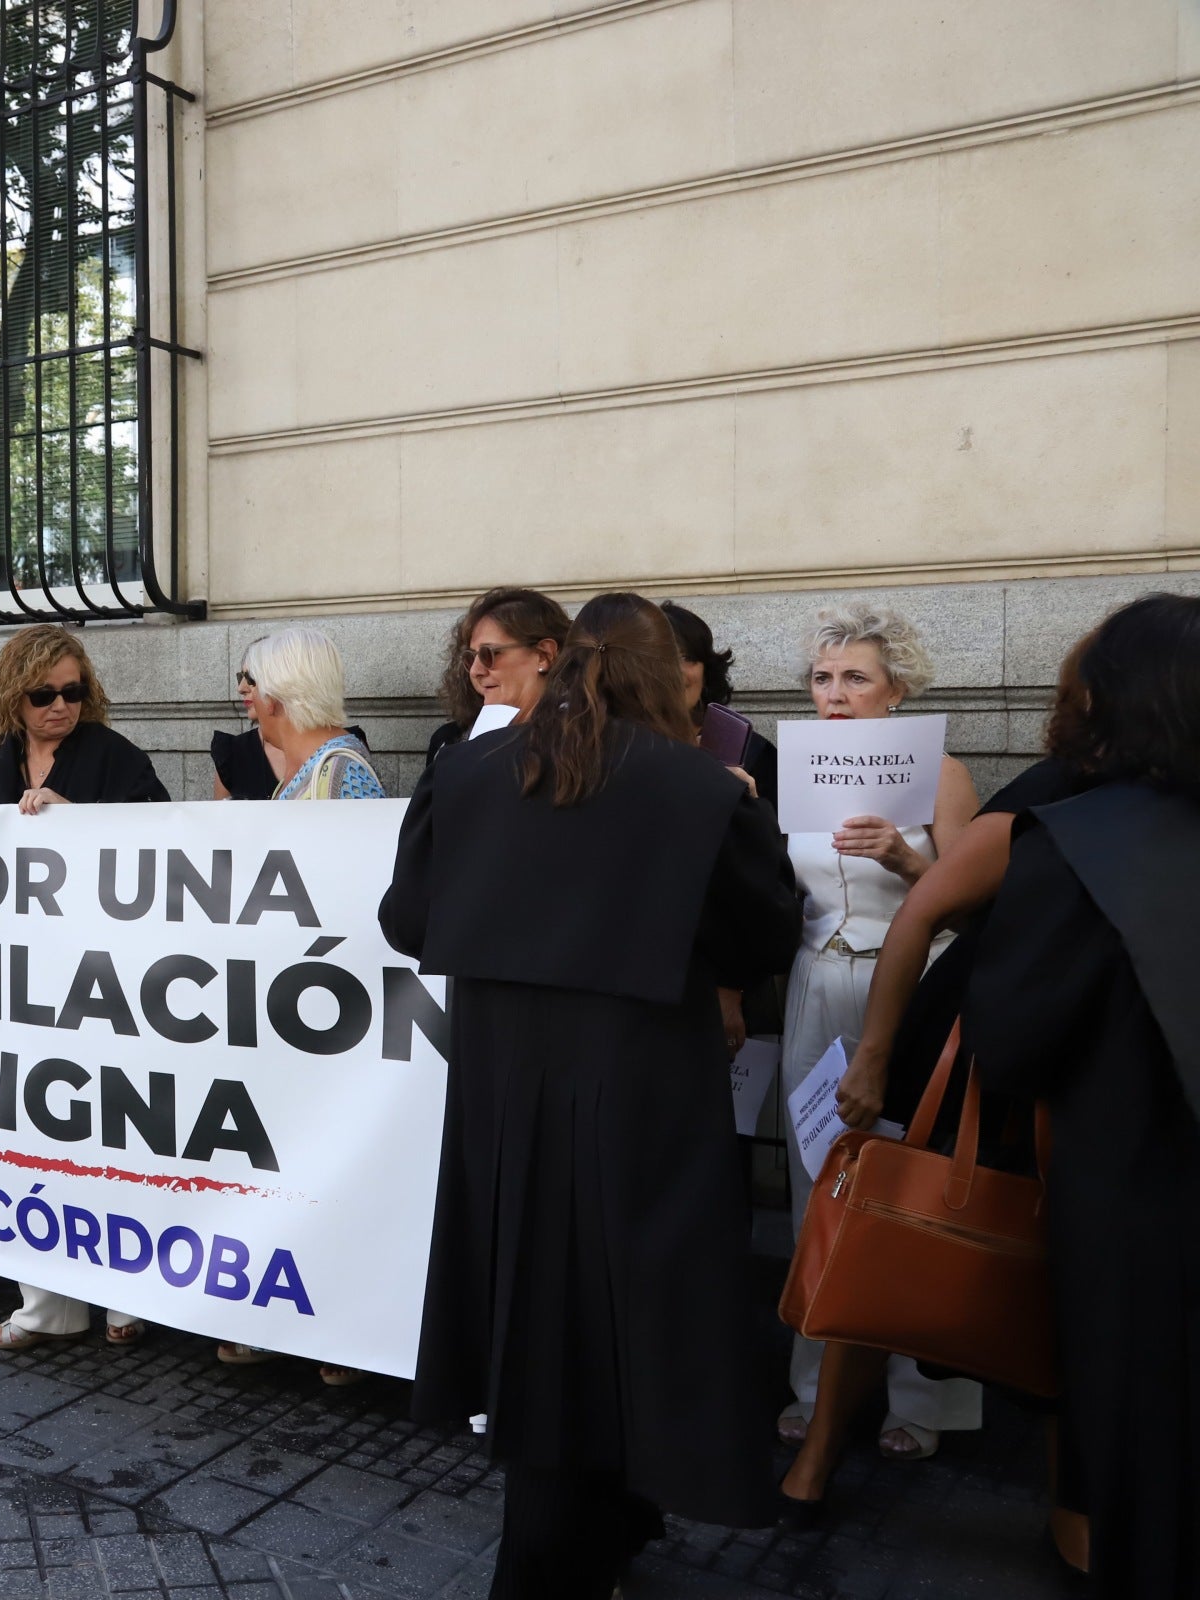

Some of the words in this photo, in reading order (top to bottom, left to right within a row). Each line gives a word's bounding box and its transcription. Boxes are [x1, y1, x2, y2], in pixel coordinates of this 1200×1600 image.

[810, 753, 915, 767] ¡PASARELA
[813, 773, 866, 786] RETA
[99, 848, 322, 928] UNA
